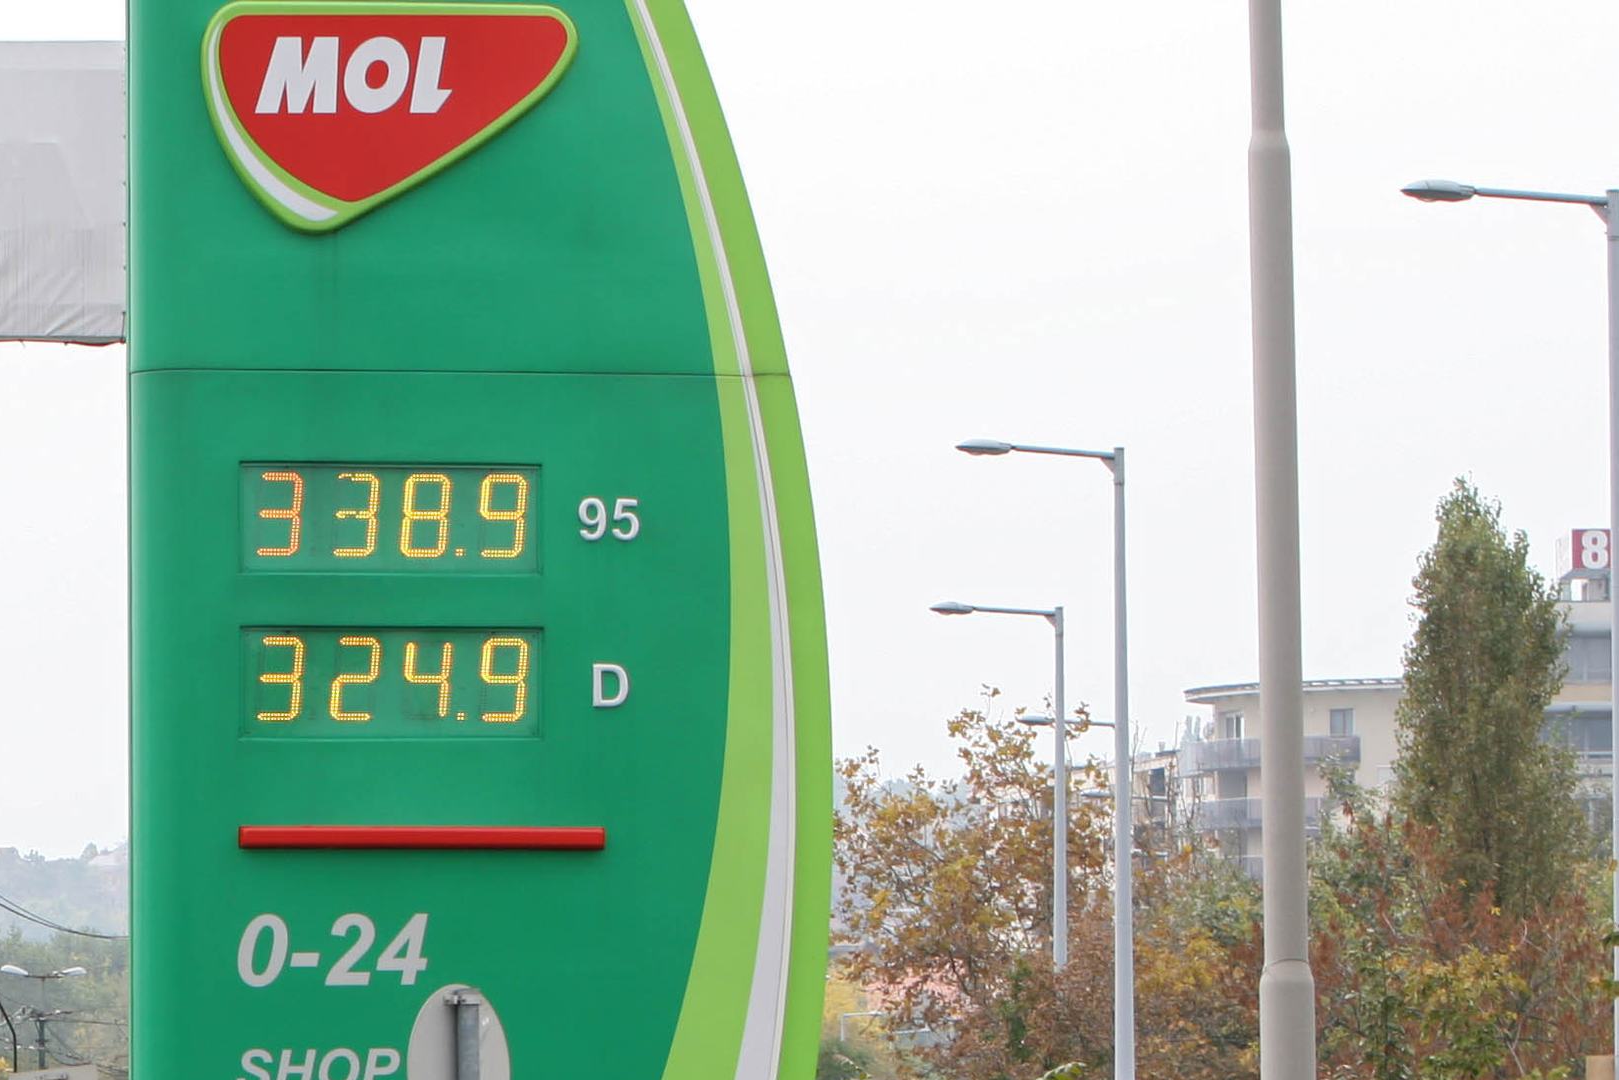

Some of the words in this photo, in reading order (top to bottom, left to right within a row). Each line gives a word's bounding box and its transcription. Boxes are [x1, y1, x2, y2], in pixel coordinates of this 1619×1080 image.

[255, 36, 453, 114] MOL
[256, 472, 530, 558] 338.9
[578, 497, 640, 541] 95
[256, 636, 530, 723] 324.9
[591, 663, 629, 707] D
[237, 913, 429, 987] 0-24
